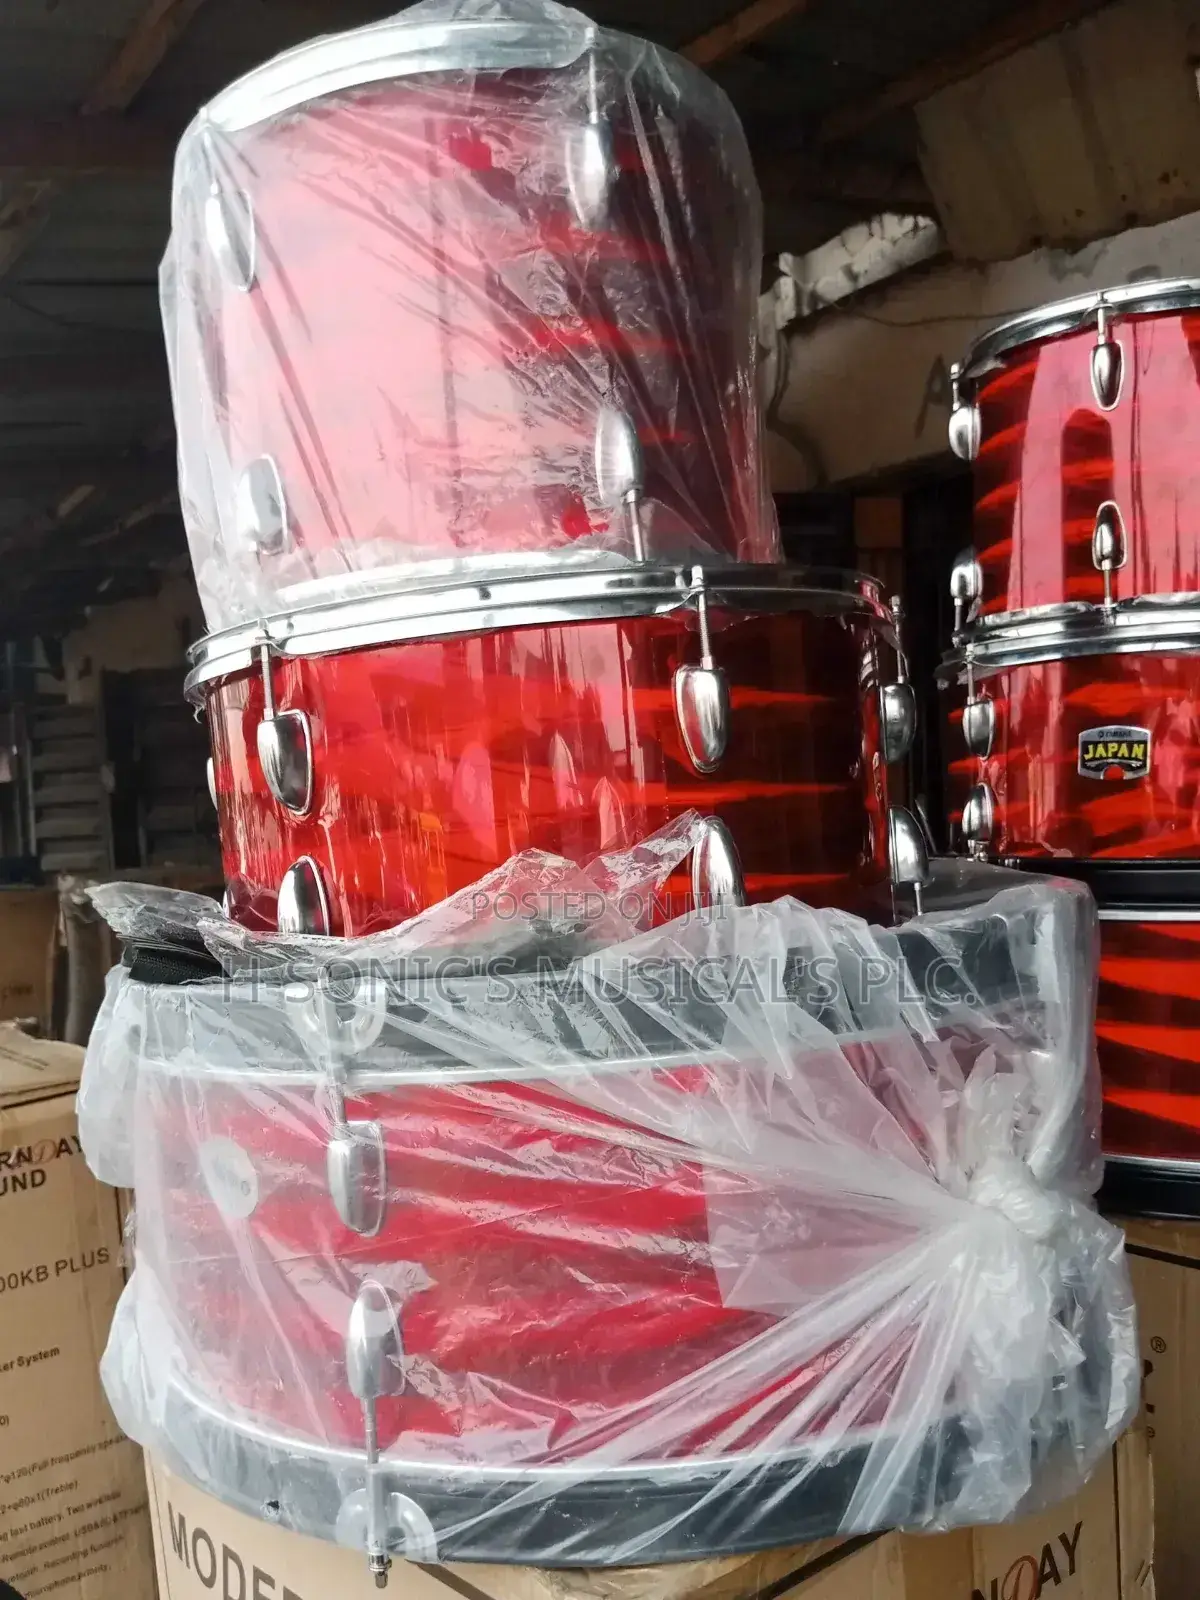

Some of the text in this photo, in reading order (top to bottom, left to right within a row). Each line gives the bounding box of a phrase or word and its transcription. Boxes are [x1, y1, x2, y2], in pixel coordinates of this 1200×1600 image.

[1083, 743, 1145, 761] JAPAN
[55, 1247, 110, 1277] PLUS
[17, 1347, 60, 1367] System
[167, 1500, 304, 1600] MODE
